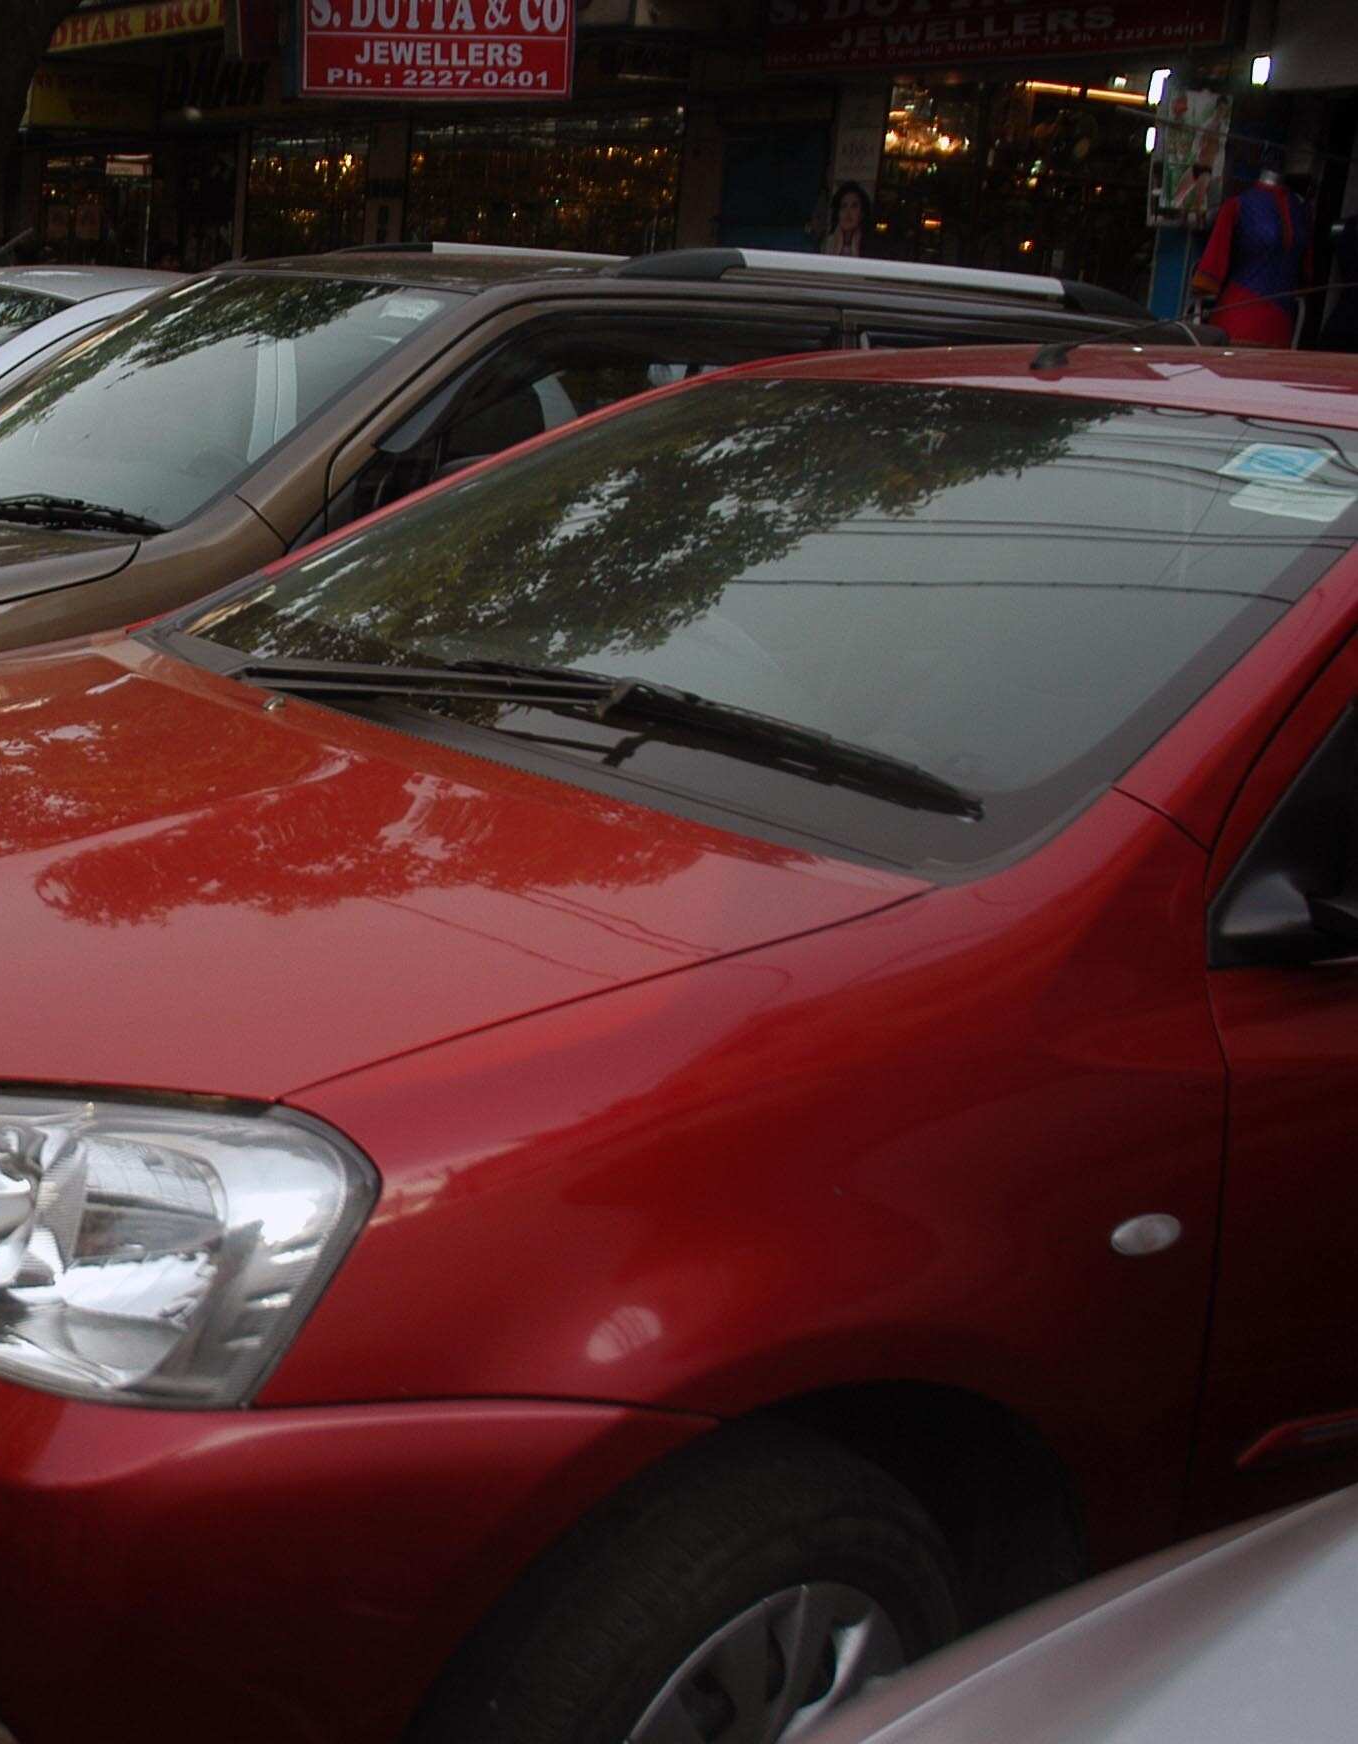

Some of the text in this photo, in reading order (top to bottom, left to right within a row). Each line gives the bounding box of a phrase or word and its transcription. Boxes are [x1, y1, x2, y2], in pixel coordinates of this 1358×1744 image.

[50, 0, 224, 47] DHAR BRO
[350, 0, 476, 31] DUTTA
[484, 0, 513, 30] &
[827, 7, 1115, 48] JEWELLERS
[355, 41, 524, 66] JEWELLERS
[327, 68, 372, 85] Ph.
[402, 70, 549, 87] 2227-0401
